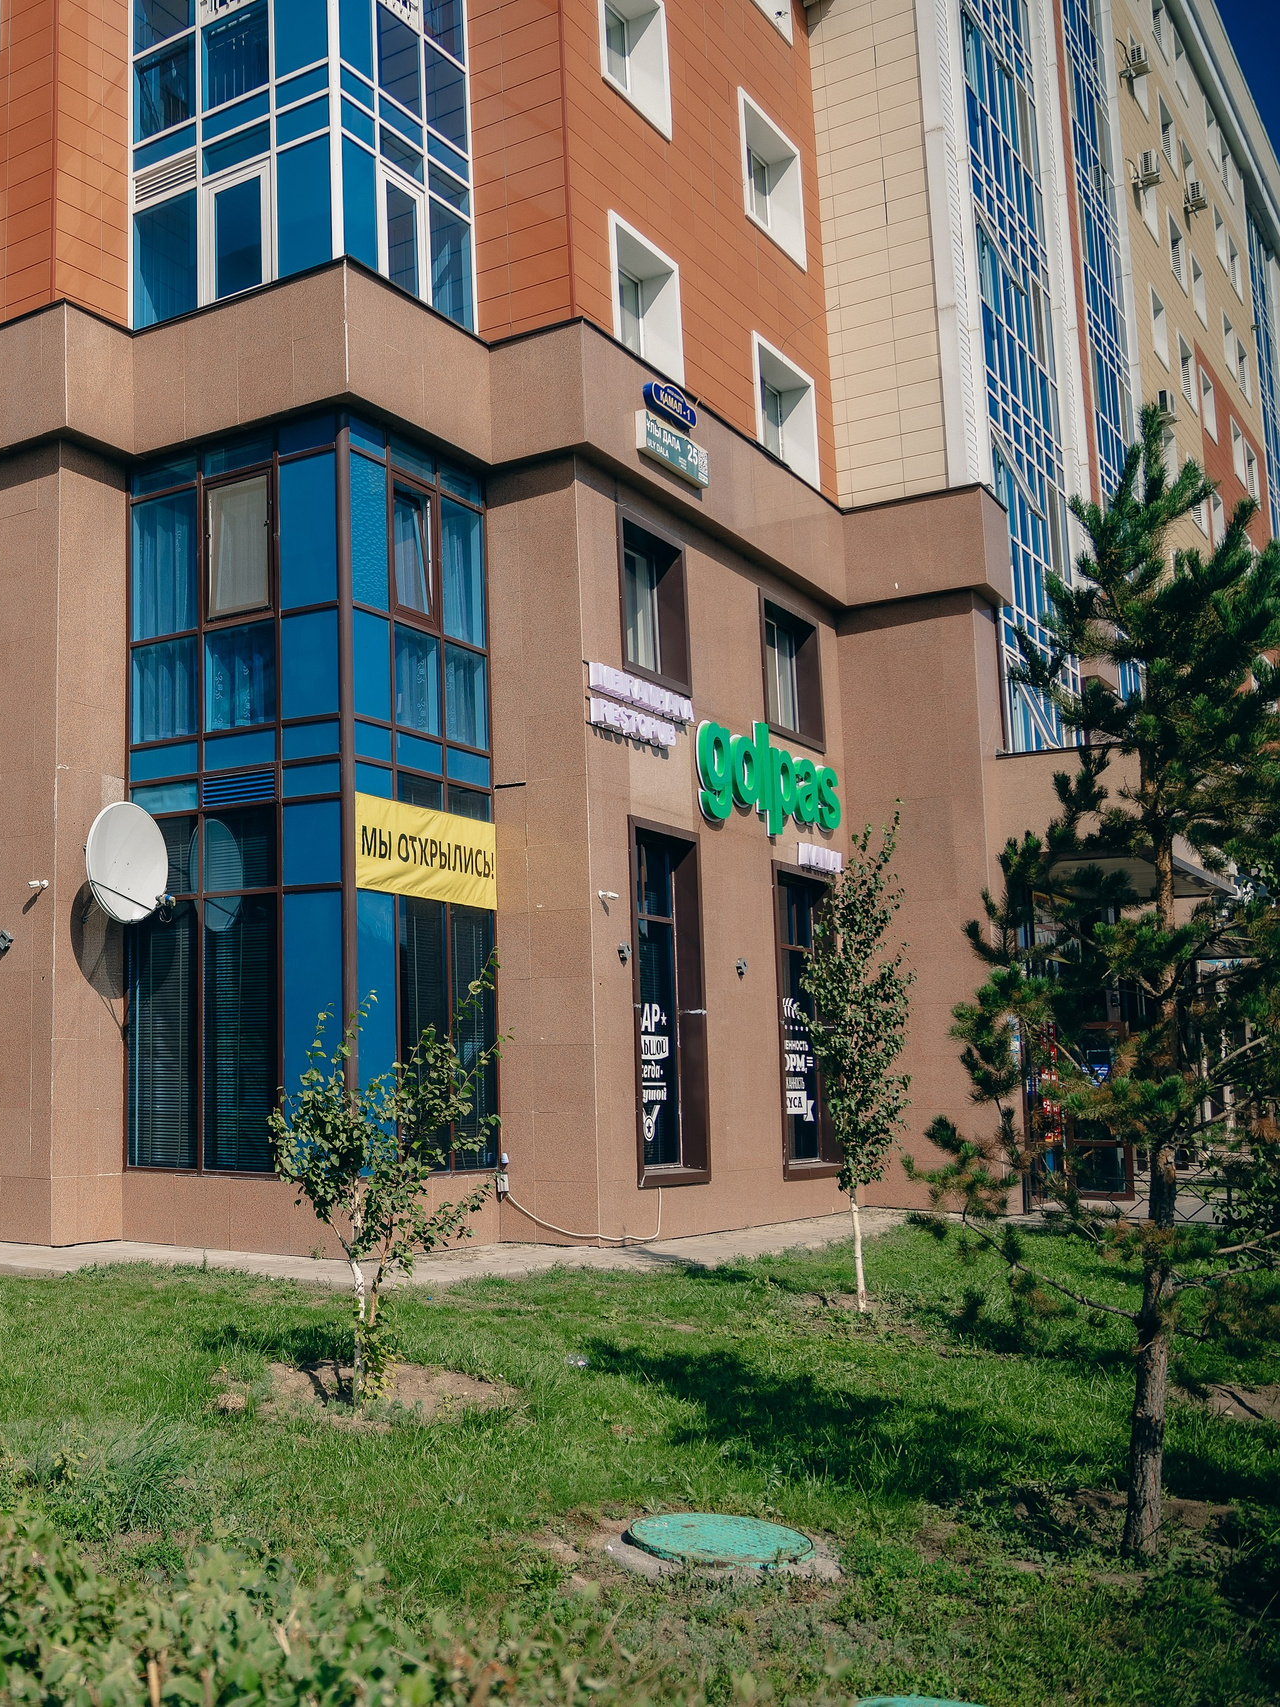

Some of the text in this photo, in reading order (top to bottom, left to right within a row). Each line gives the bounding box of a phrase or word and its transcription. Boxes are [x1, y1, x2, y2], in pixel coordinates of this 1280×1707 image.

[647, 438, 670, 458] ULY DALA
[662, 429, 681, 452] ДАЛА
[687, 444, 698, 466] 25
[590, 697, 677, 746] RESTOPUB
[696, 720, 841, 837] golpas
[361, 825, 494, 880] МЫ ОТКРЫЛИСЬ!
[641, 1003, 661, 1032] АР
[784, 1039, 809, 1051] ЕННОСТЬ
